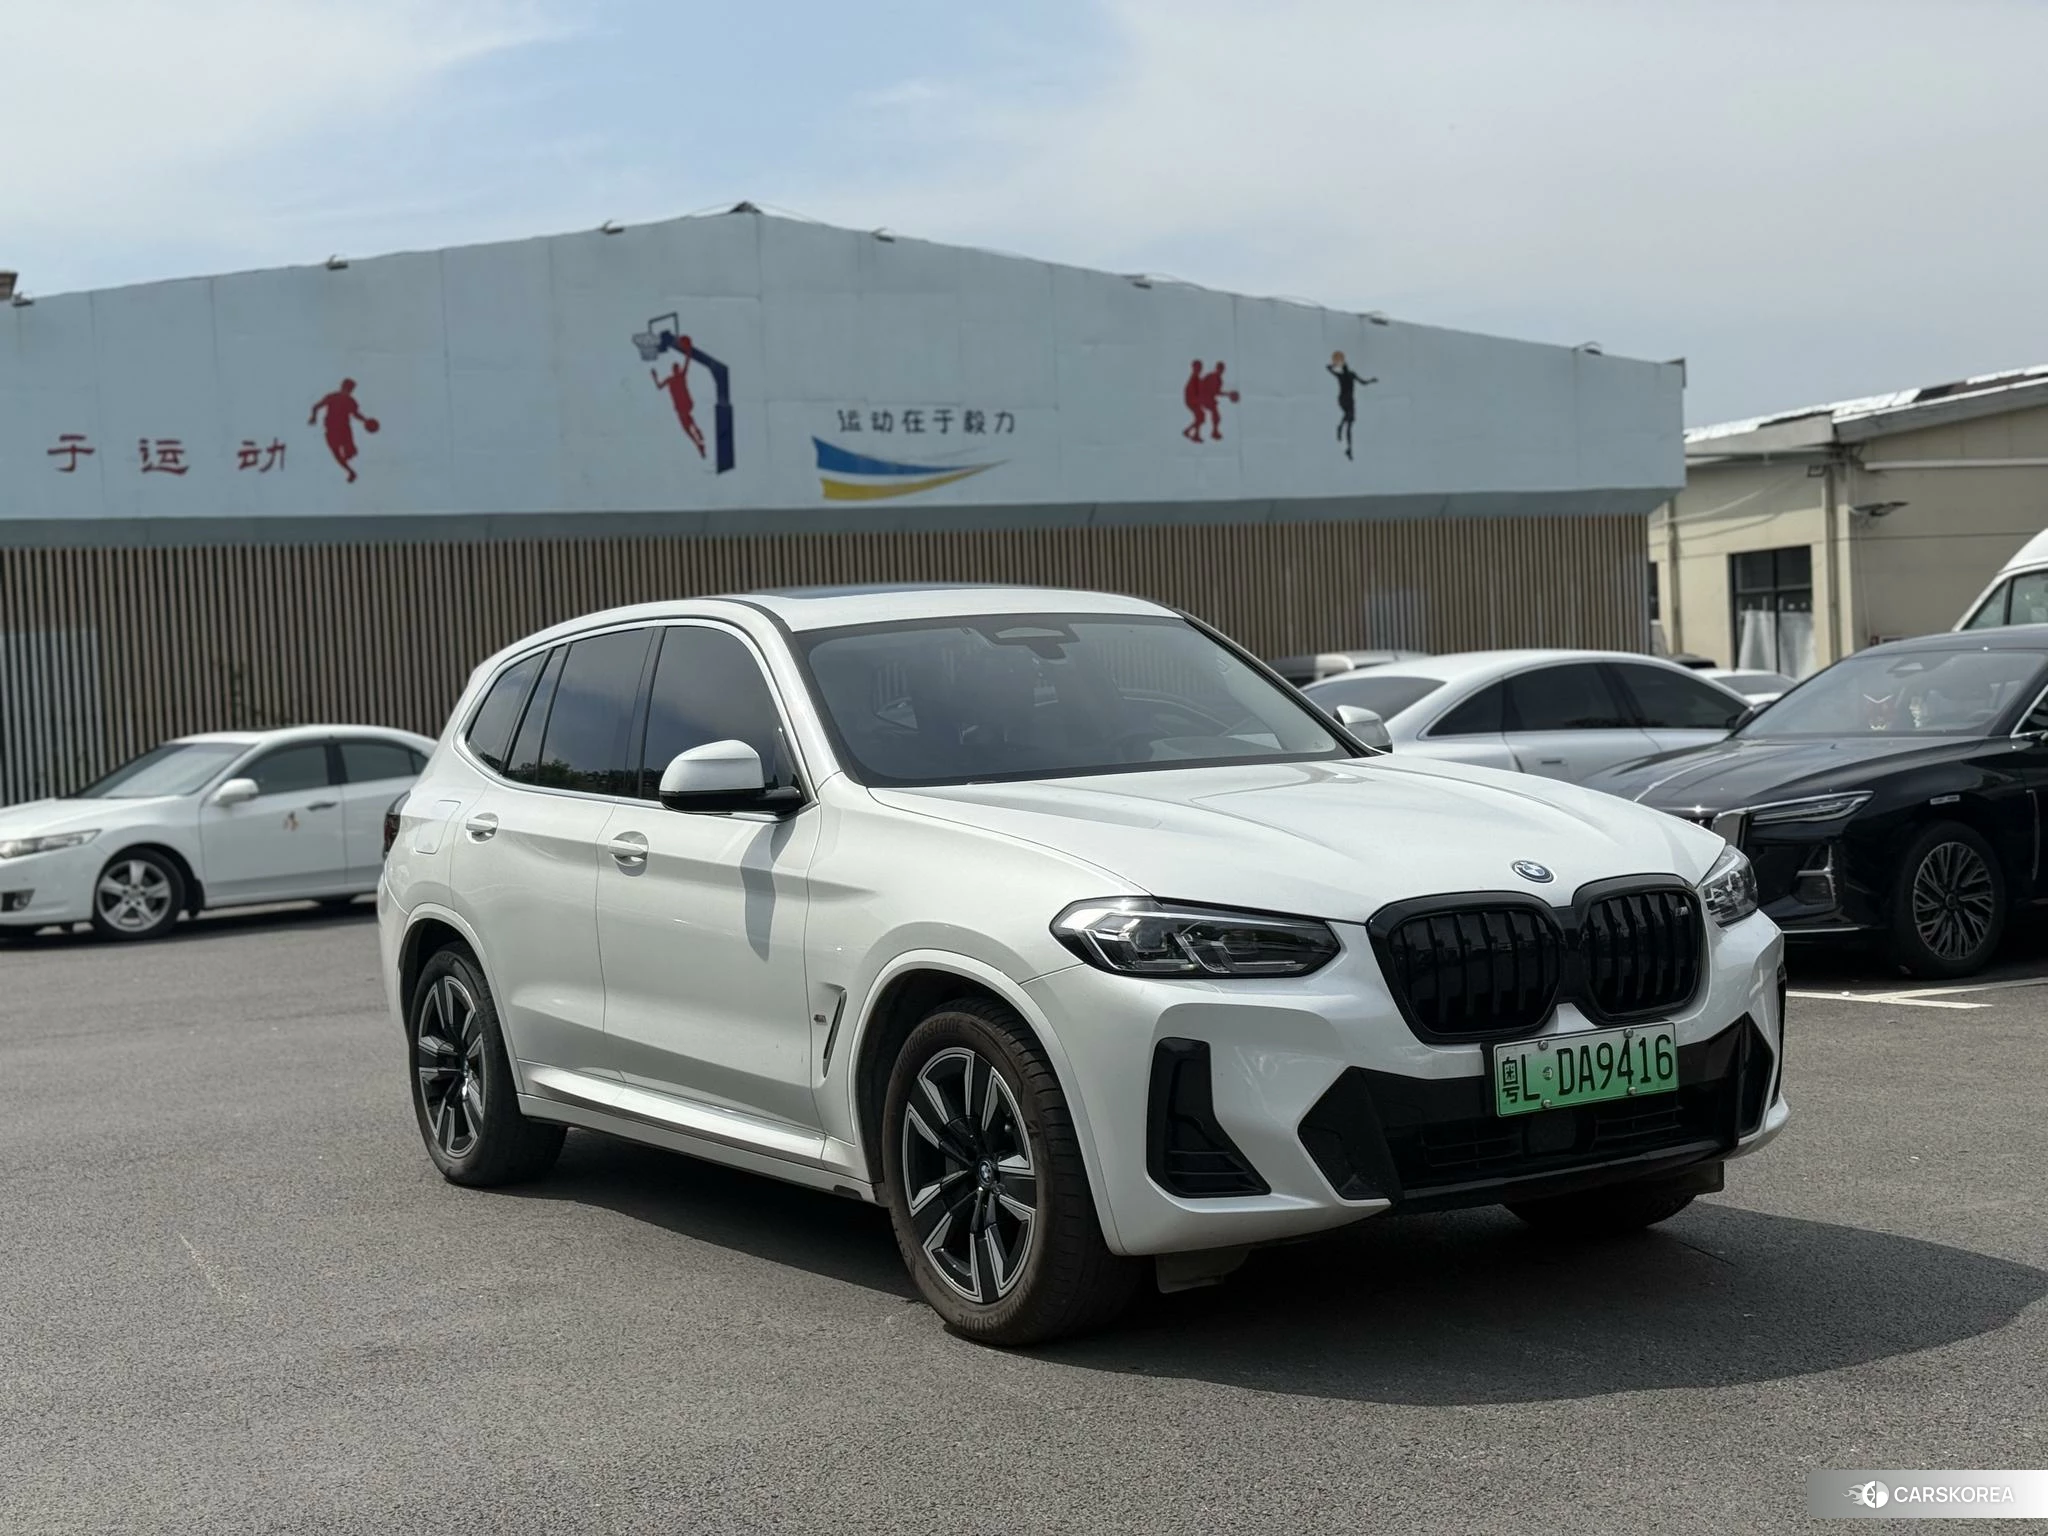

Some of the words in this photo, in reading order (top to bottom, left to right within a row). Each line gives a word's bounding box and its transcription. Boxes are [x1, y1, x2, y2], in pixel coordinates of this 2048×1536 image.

[837, 409, 1016, 434] 运动在于毅力
[47, 434, 287, 475] 于运动
